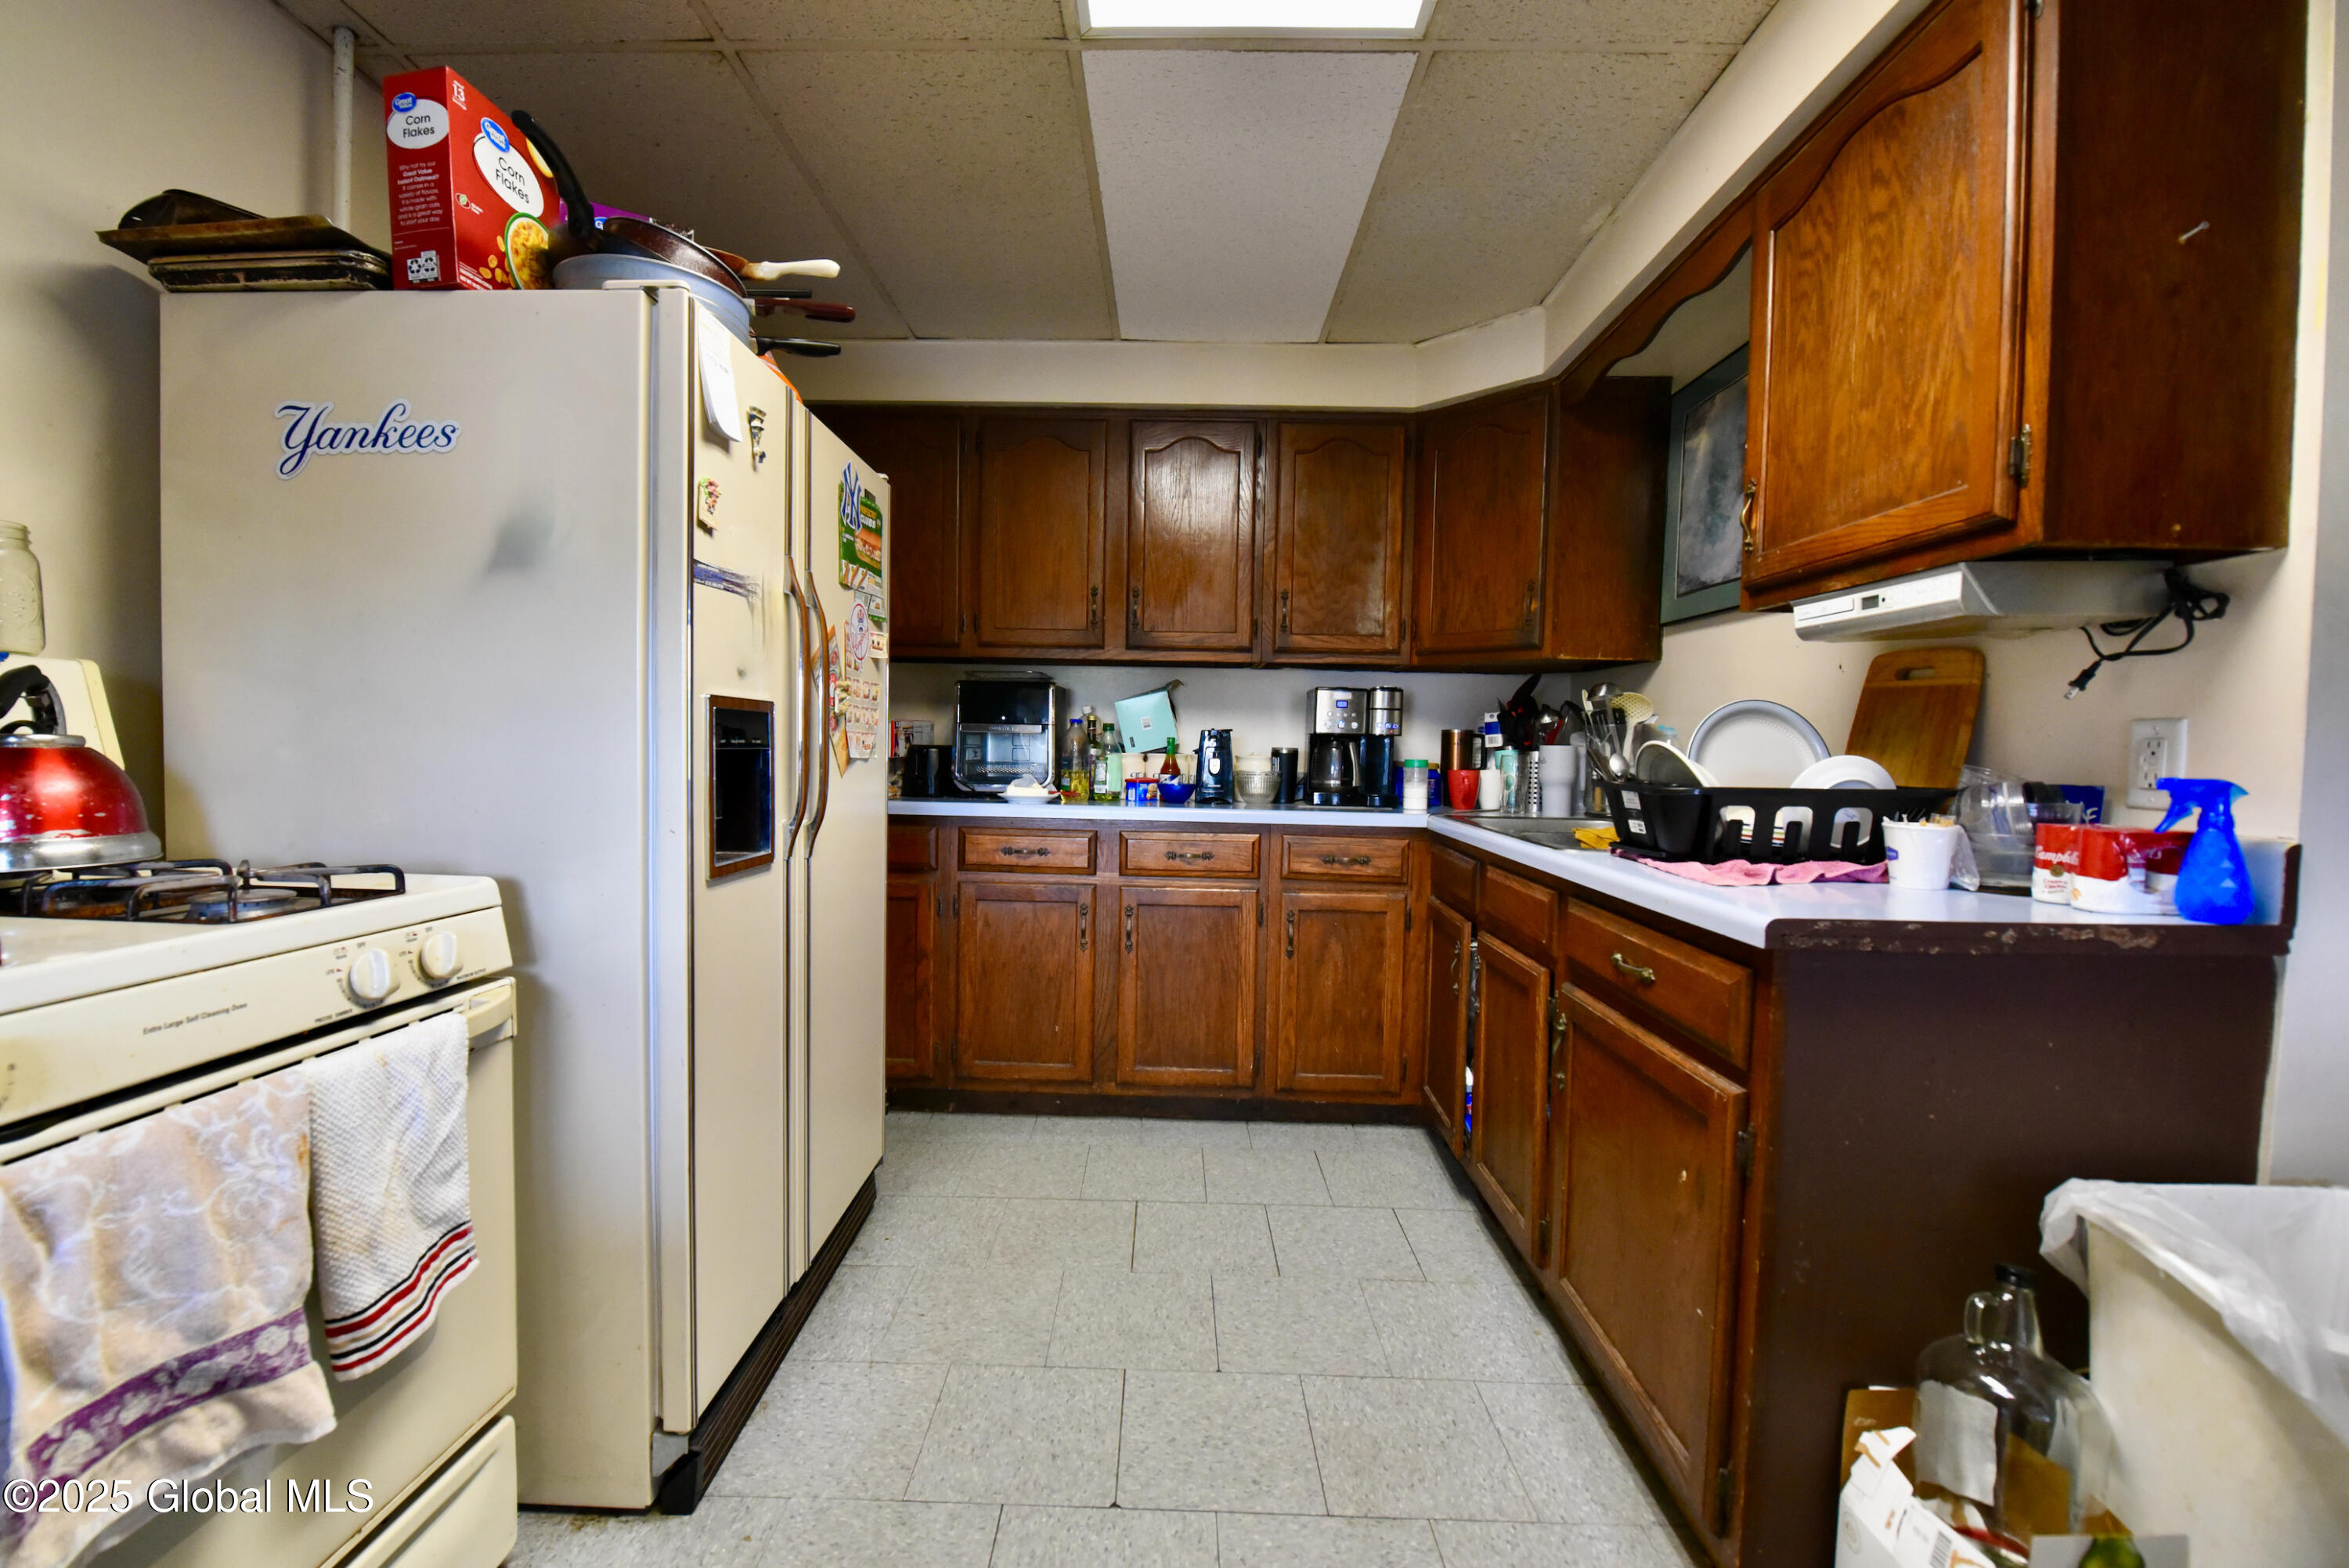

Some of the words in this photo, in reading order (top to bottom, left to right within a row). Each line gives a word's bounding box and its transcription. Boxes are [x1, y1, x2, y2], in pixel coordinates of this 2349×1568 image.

[402, 126, 435, 138] Flakes
[406, 114, 431, 125] Corn
[499, 157, 525, 186] Corn
[496, 168, 529, 204] Flakes
[277, 402, 456, 476] Yankees
[143, 1026, 162, 1035] Extra
[163, 1020, 183, 1029] Large
[186, 1015, 199, 1023] Self
[200, 1007, 229, 1019] Cleaning
